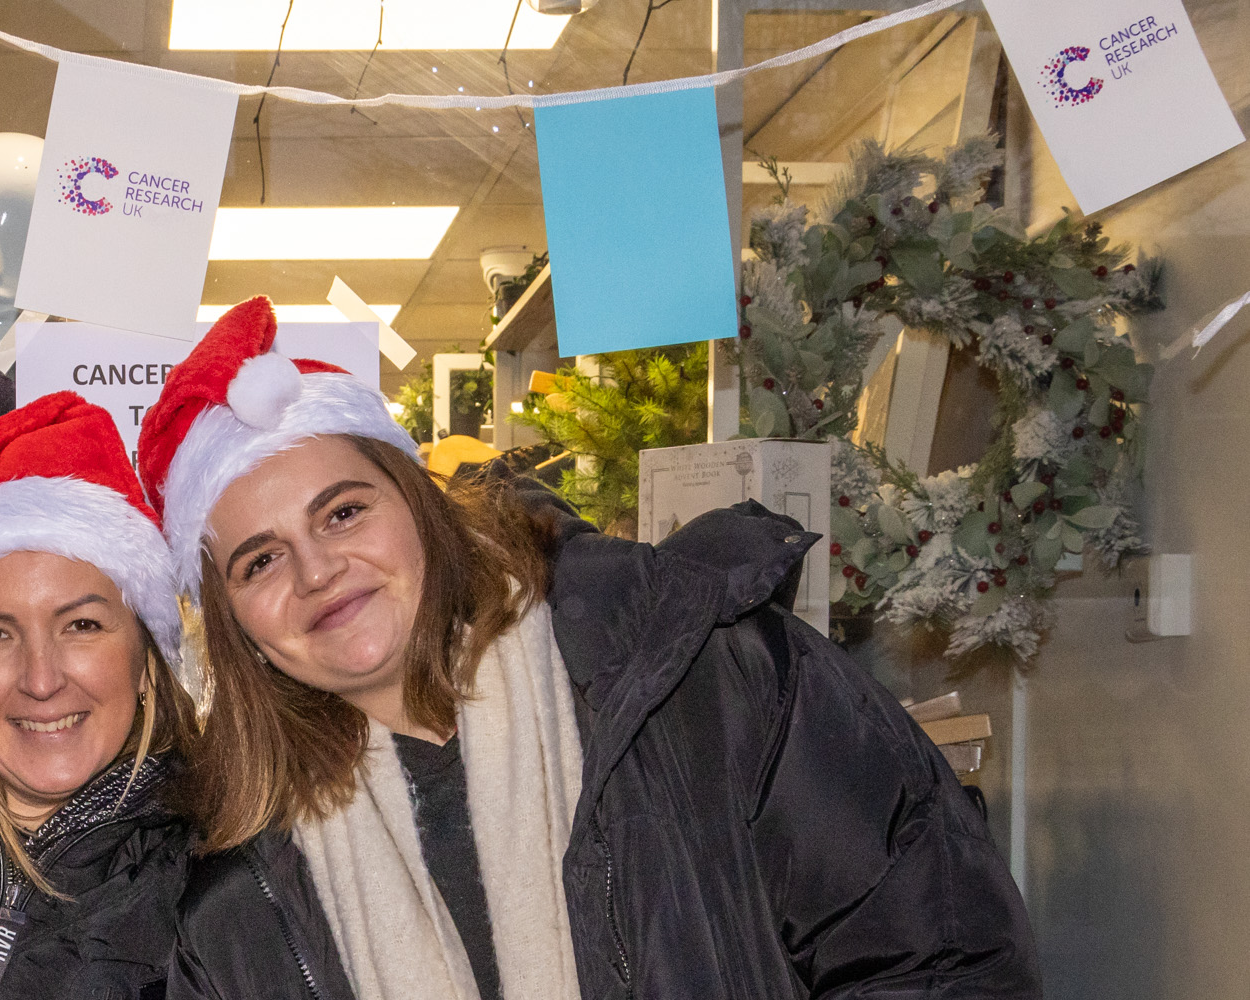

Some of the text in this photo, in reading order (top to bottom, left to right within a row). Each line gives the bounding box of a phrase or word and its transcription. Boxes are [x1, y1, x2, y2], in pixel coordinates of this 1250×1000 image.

[1098, 15, 1158, 51] CANCER
[1104, 22, 1178, 66] RESEARCH
[1110, 61, 1132, 80] UK
[128, 171, 190, 194] CANCER
[122, 202, 144, 218] UK
[125, 186, 204, 213] RESEARCH
